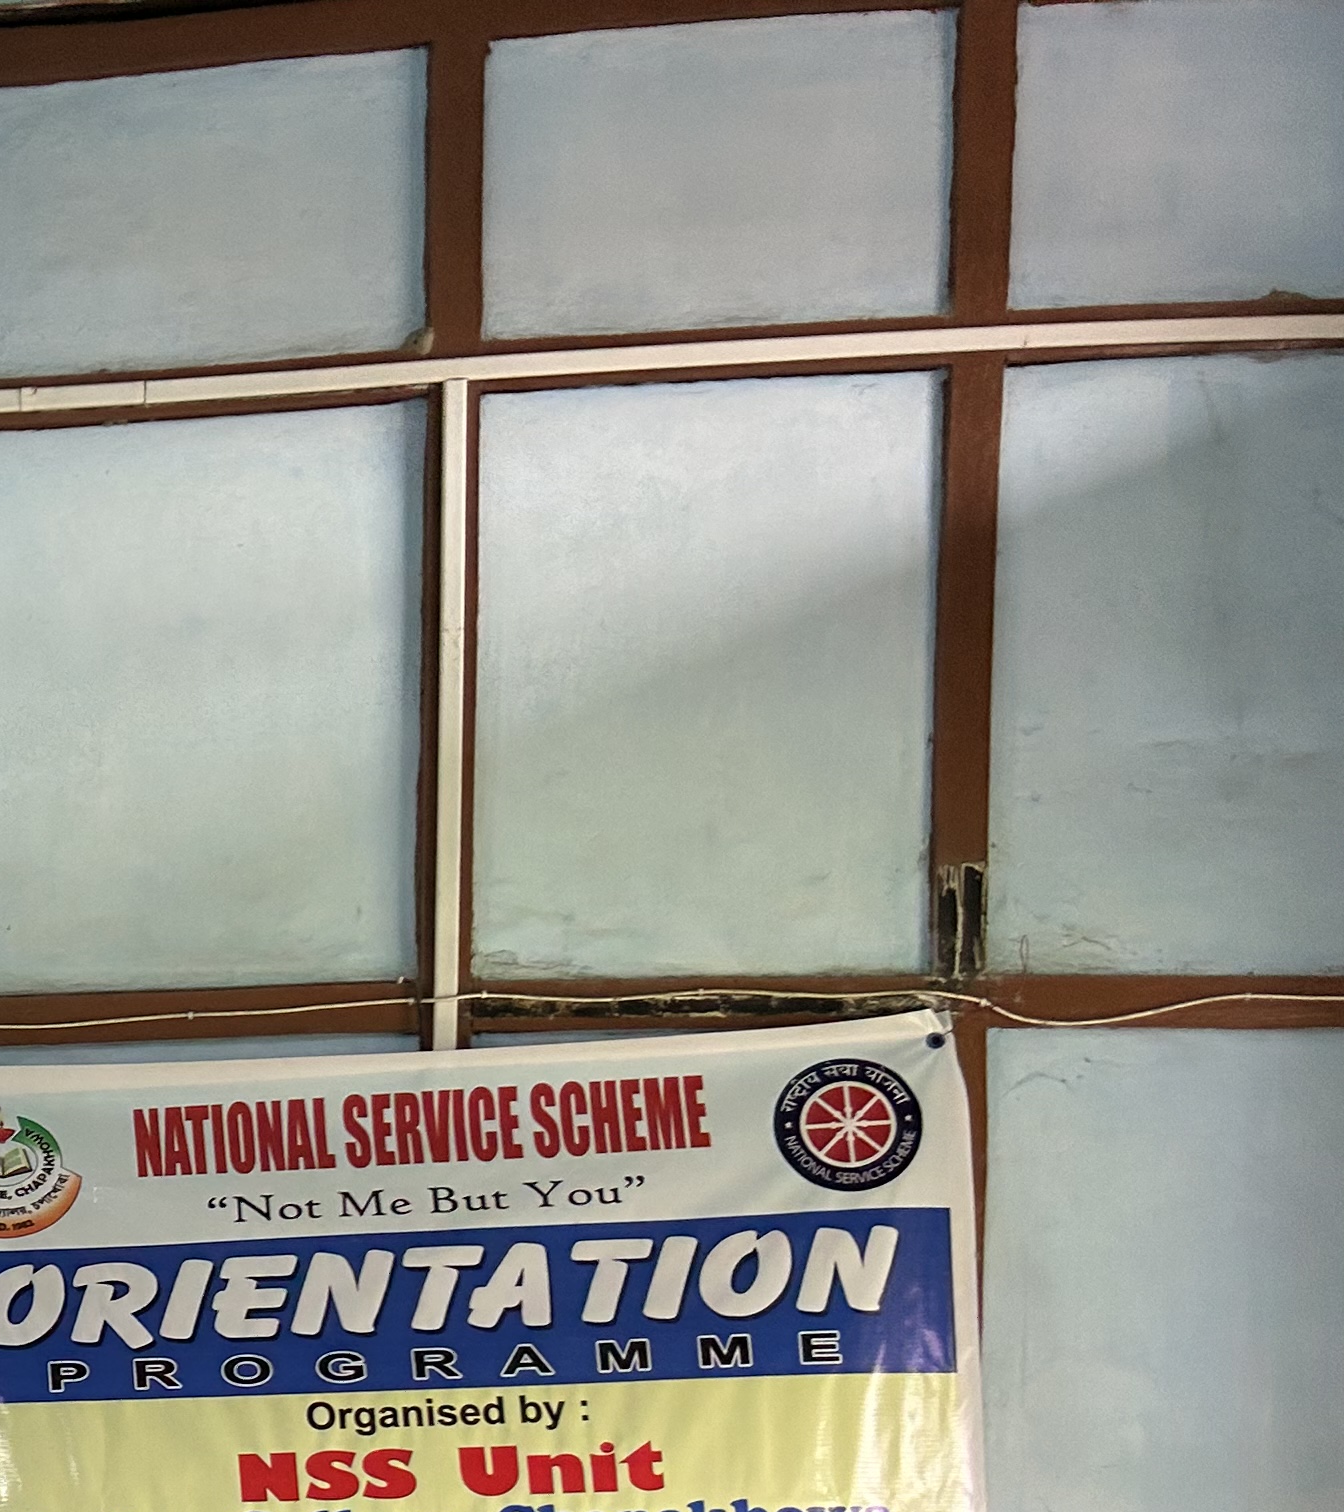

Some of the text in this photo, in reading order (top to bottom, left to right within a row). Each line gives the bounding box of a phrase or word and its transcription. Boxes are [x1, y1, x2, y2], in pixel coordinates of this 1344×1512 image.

[132, 1075, 712, 1178] NATIONAL SERVICE SCHEME
[784, 1130, 917, 1185] NATIONAL SERVICE SCHEME
[14, 1128, 56, 1198] CHAPAKHOWA
[338, 1189, 413, 1218] Me
[427, 1186, 509, 1214] But
[46, 1328, 844, 1394] PROGRAMME
[306, 1397, 505, 1436] Organised
[518, 1395, 566, 1430] by
[238, 1440, 667, 1504] NSS Unit
